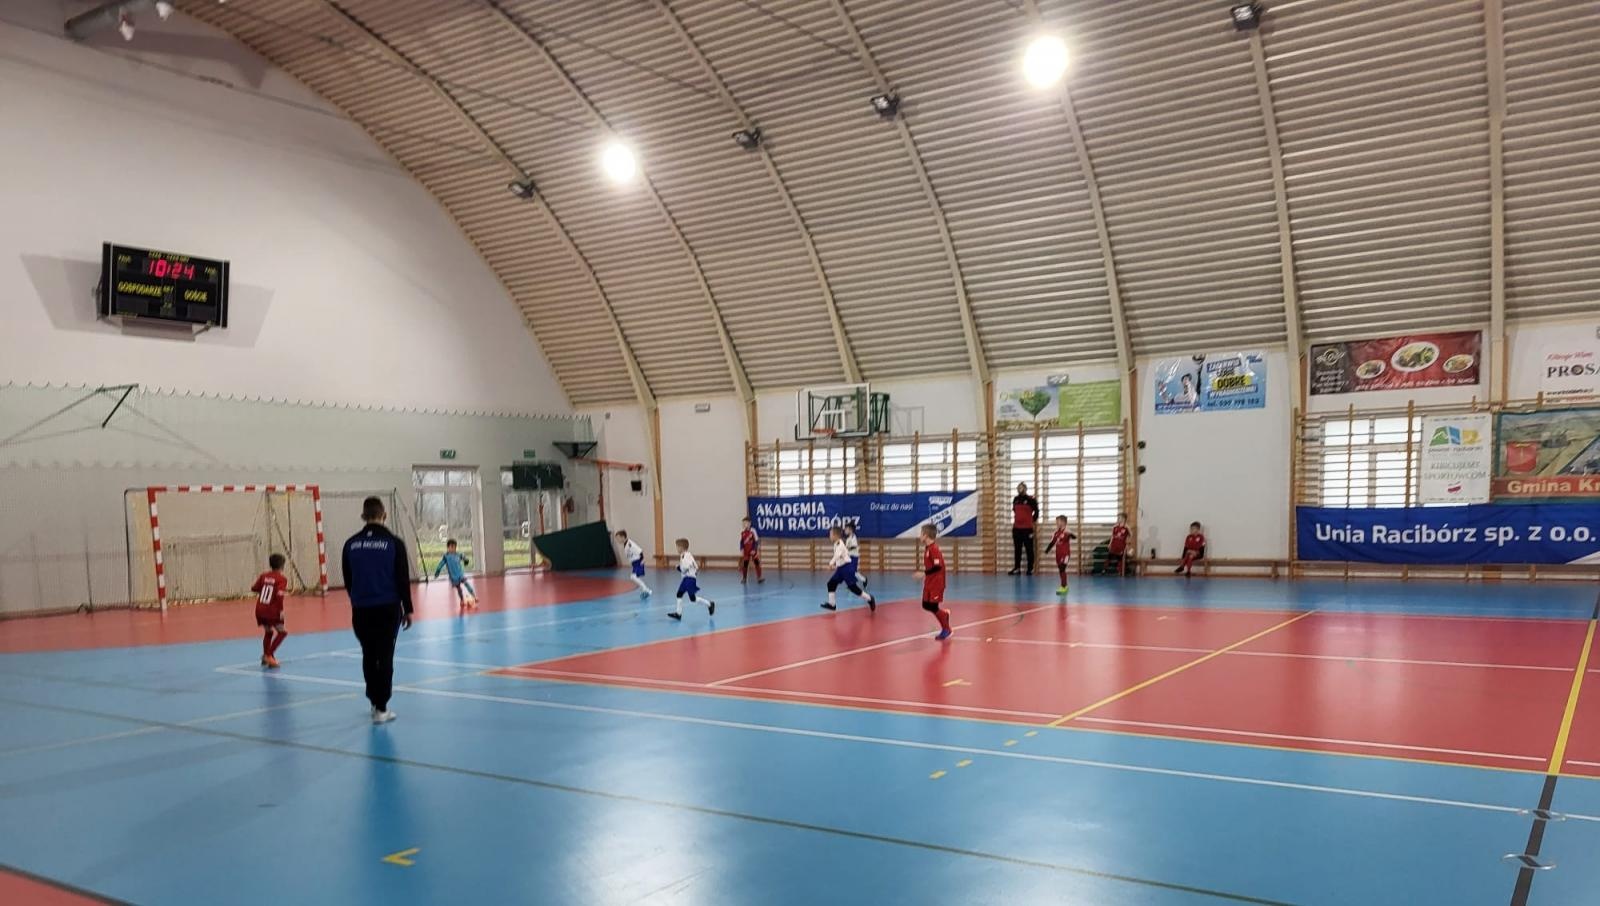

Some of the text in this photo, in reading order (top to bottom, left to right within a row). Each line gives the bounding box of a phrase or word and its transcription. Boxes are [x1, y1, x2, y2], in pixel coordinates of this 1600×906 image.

[149, 259, 195, 280] 10:24
[1217, 375, 1246, 389] DOBRE
[1507, 480, 1572, 493] Gmina
[756, 501, 826, 517] AKADEMIA
[757, 513, 861, 531] UNII RACIBÓRZ
[1315, 522, 1596, 547] Unia Racibórz sp. z o.o.
[260, 585, 274, 604] 10
